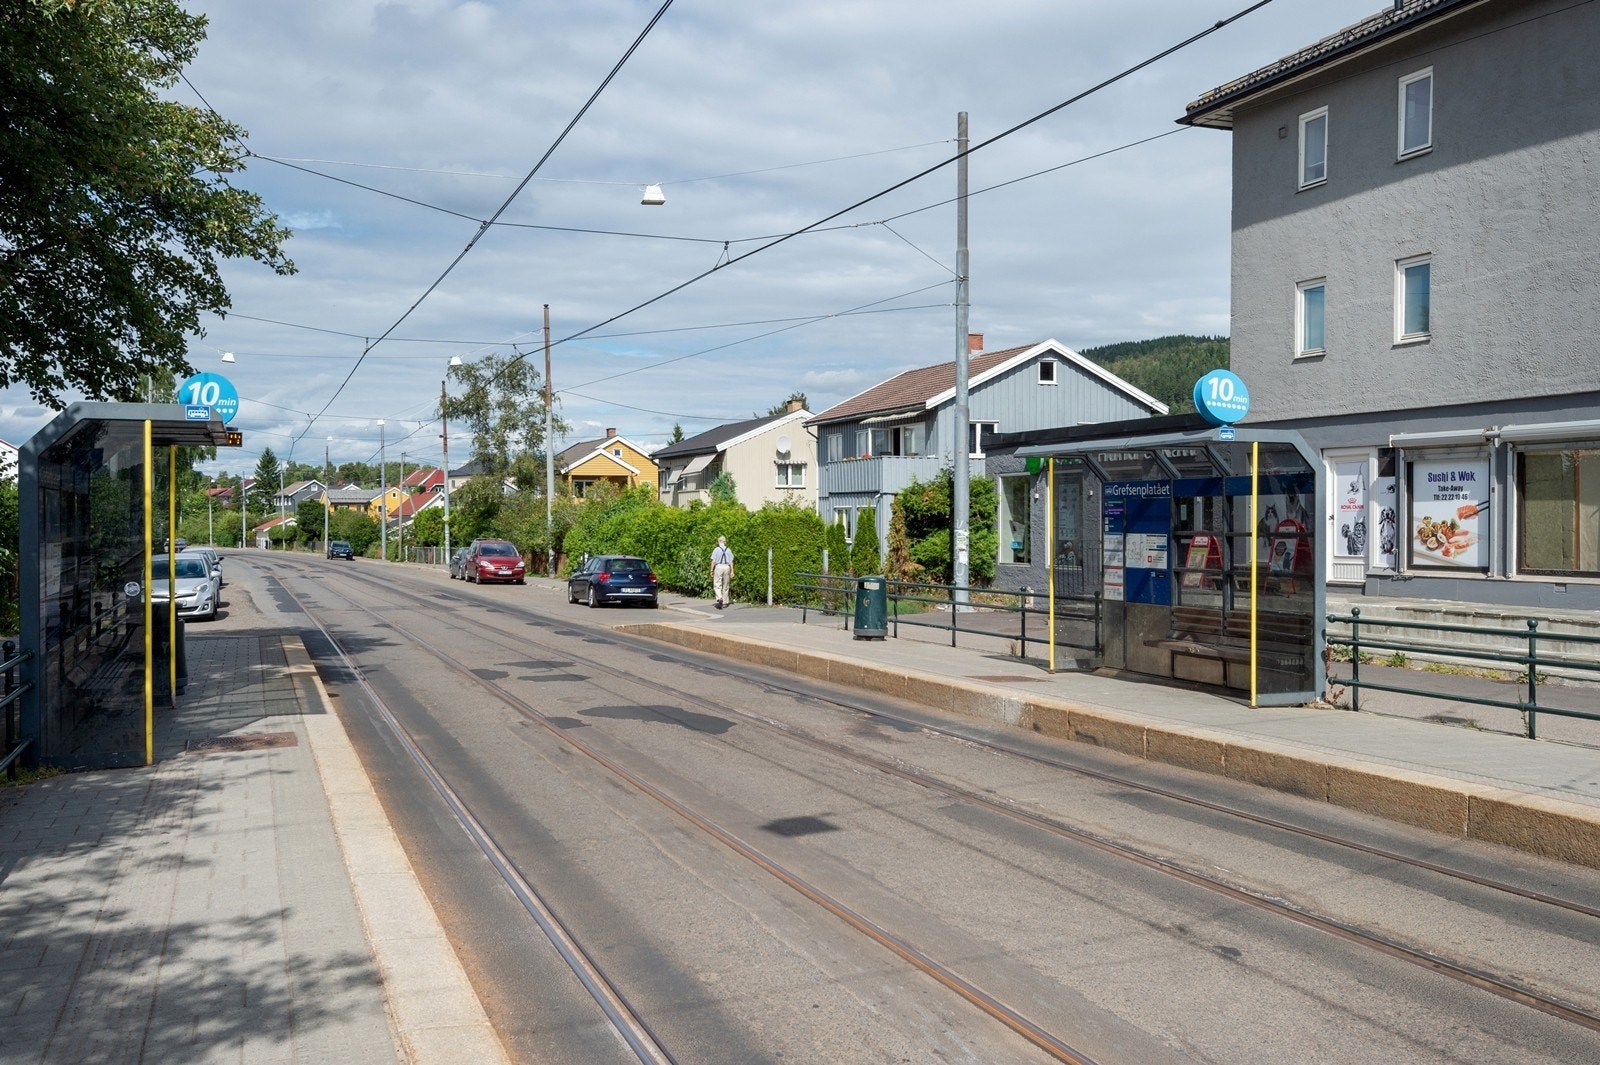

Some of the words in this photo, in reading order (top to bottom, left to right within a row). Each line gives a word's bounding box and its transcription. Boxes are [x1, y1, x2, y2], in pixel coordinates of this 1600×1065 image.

[188, 381, 220, 406] 10
[218, 397, 237, 406] min
[1208, 377, 1234, 401] 10
[1233, 395, 1248, 403] min
[1427, 472, 1448, 483] Sushi
[1450, 471, 1456, 481] &
[1458, 471, 1476, 482] Wok
[1112, 482, 1170, 499] Grefsenplatået
